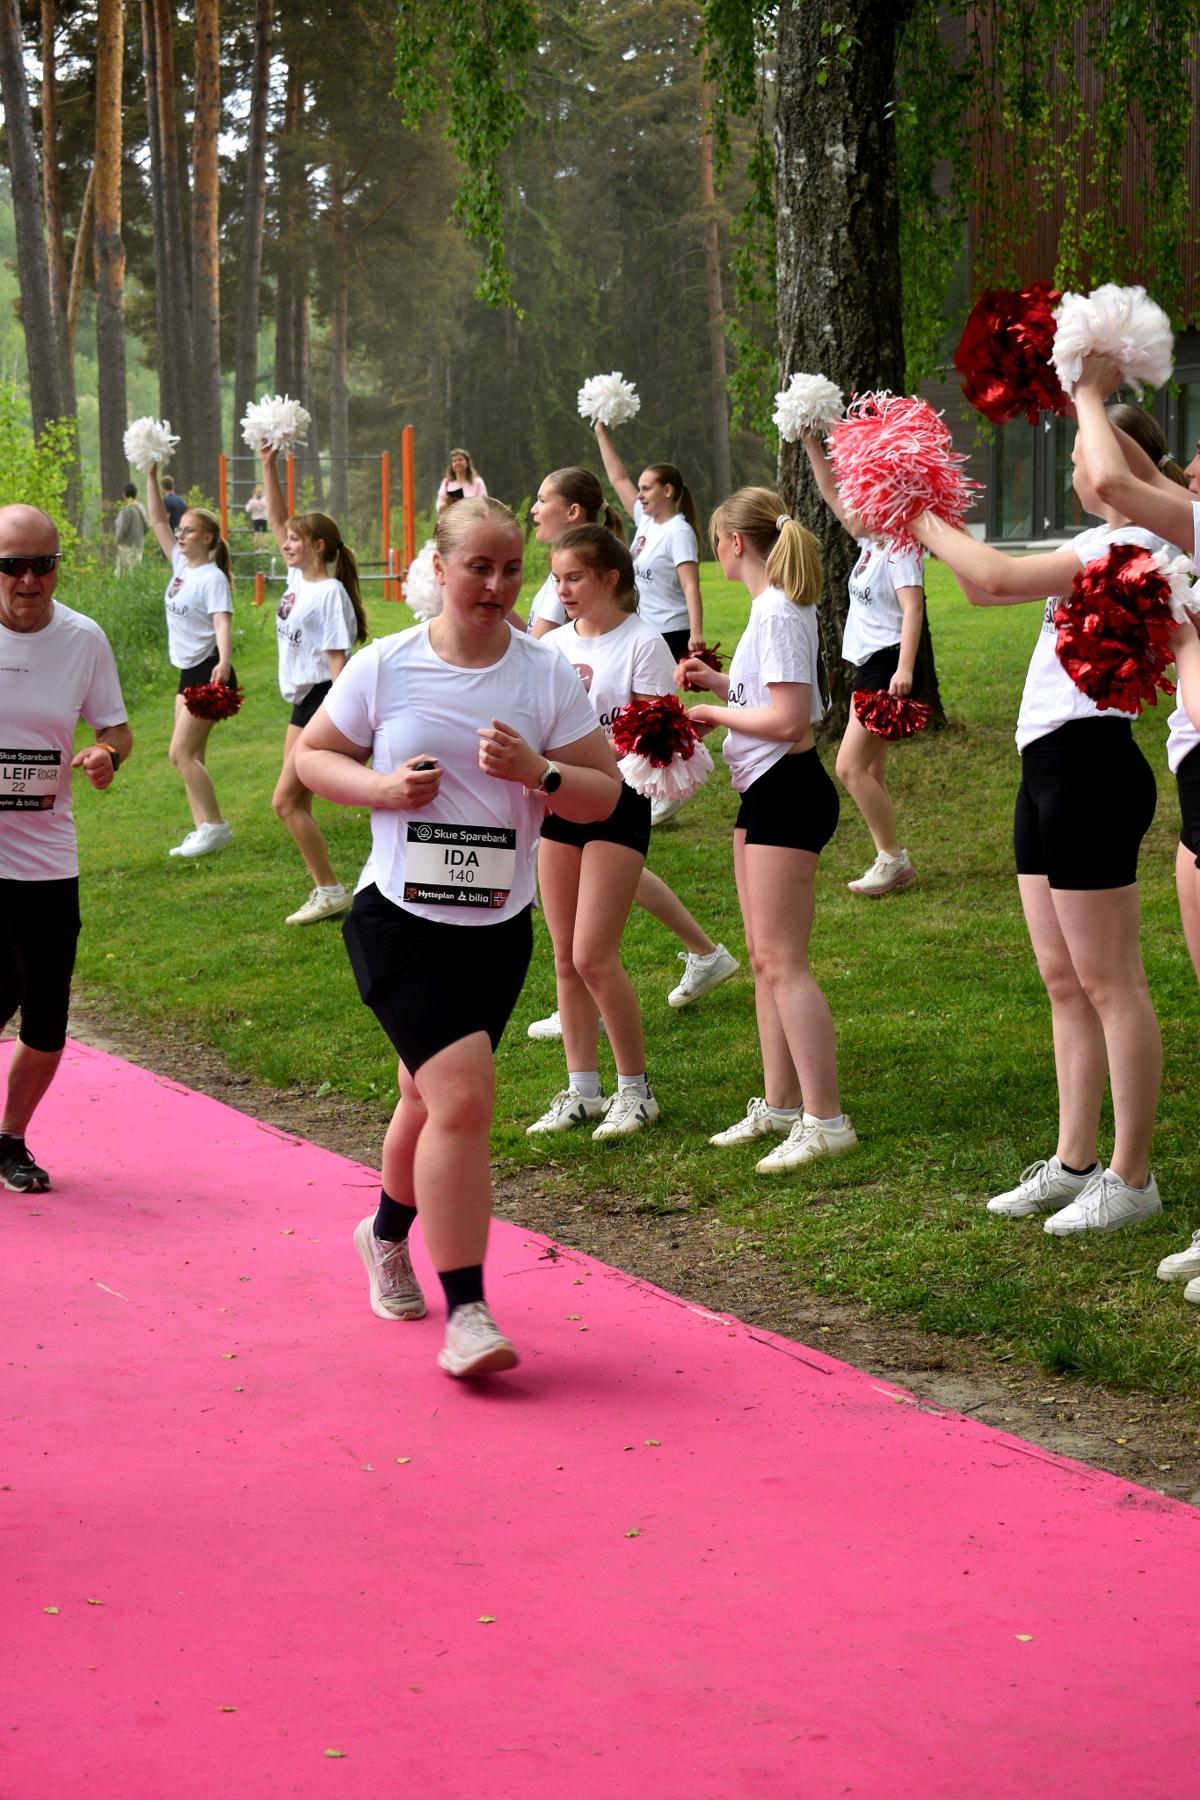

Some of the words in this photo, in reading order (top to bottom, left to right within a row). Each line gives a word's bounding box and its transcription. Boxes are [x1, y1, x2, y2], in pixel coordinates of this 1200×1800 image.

[17, 752, 55, 762] Sparebank
[3, 767, 36, 780] LEIF
[11, 782, 26, 792] 22
[434, 828, 458, 839] Skue
[460, 830, 508, 844] Sparebank
[444, 849, 480, 867] IDA
[448, 869, 475, 883] 140
[418, 890, 455, 900] Hytteplan
[468, 893, 489, 903] bilia
